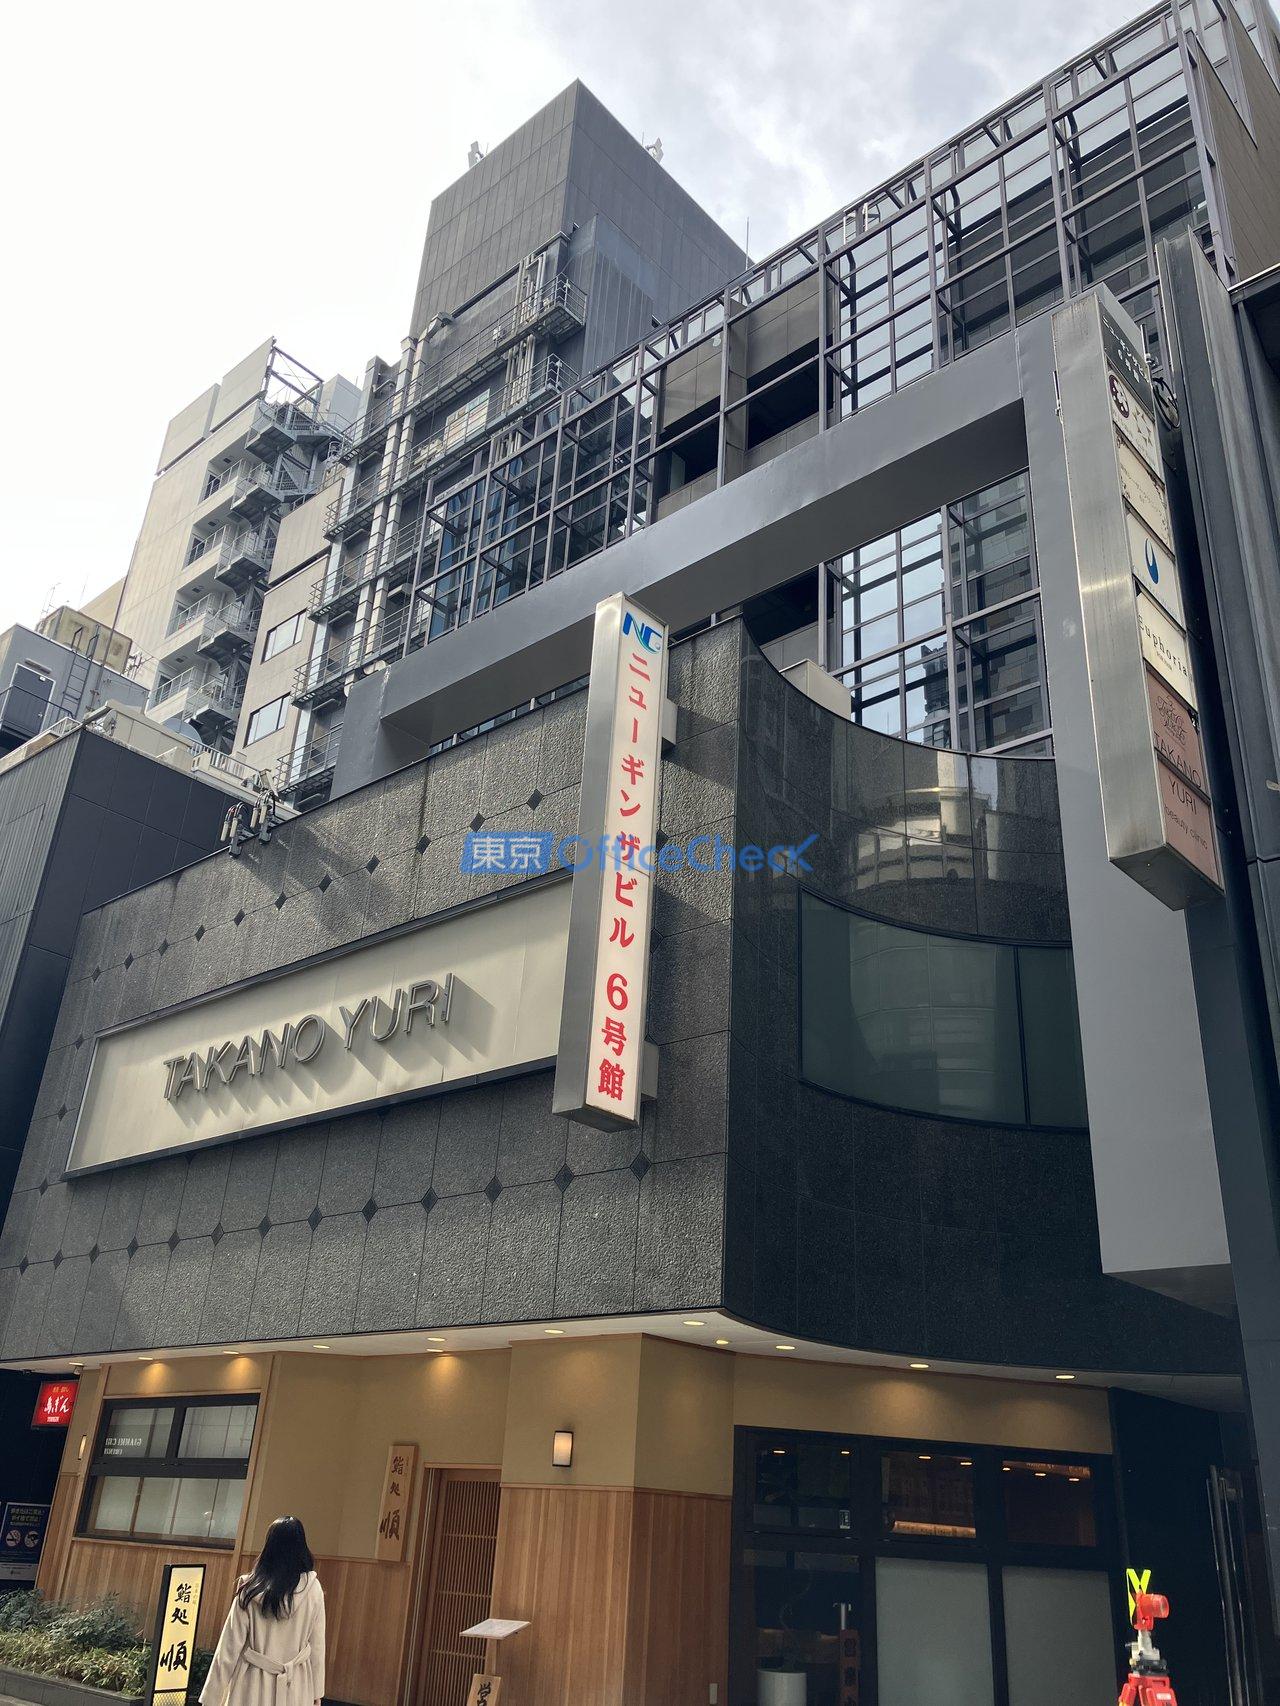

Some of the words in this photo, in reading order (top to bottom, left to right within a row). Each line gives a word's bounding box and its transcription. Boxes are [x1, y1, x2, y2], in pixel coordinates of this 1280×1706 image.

[1153, 730, 1202, 788] TAKANO
[1168, 776, 1198, 815] YURI
[163, 1013, 326, 1102] TAKANO
[339, 972, 456, 1052] YURI
[598, 973, 628, 1101] 6号館
[160, 1640, 188, 1672] 順
